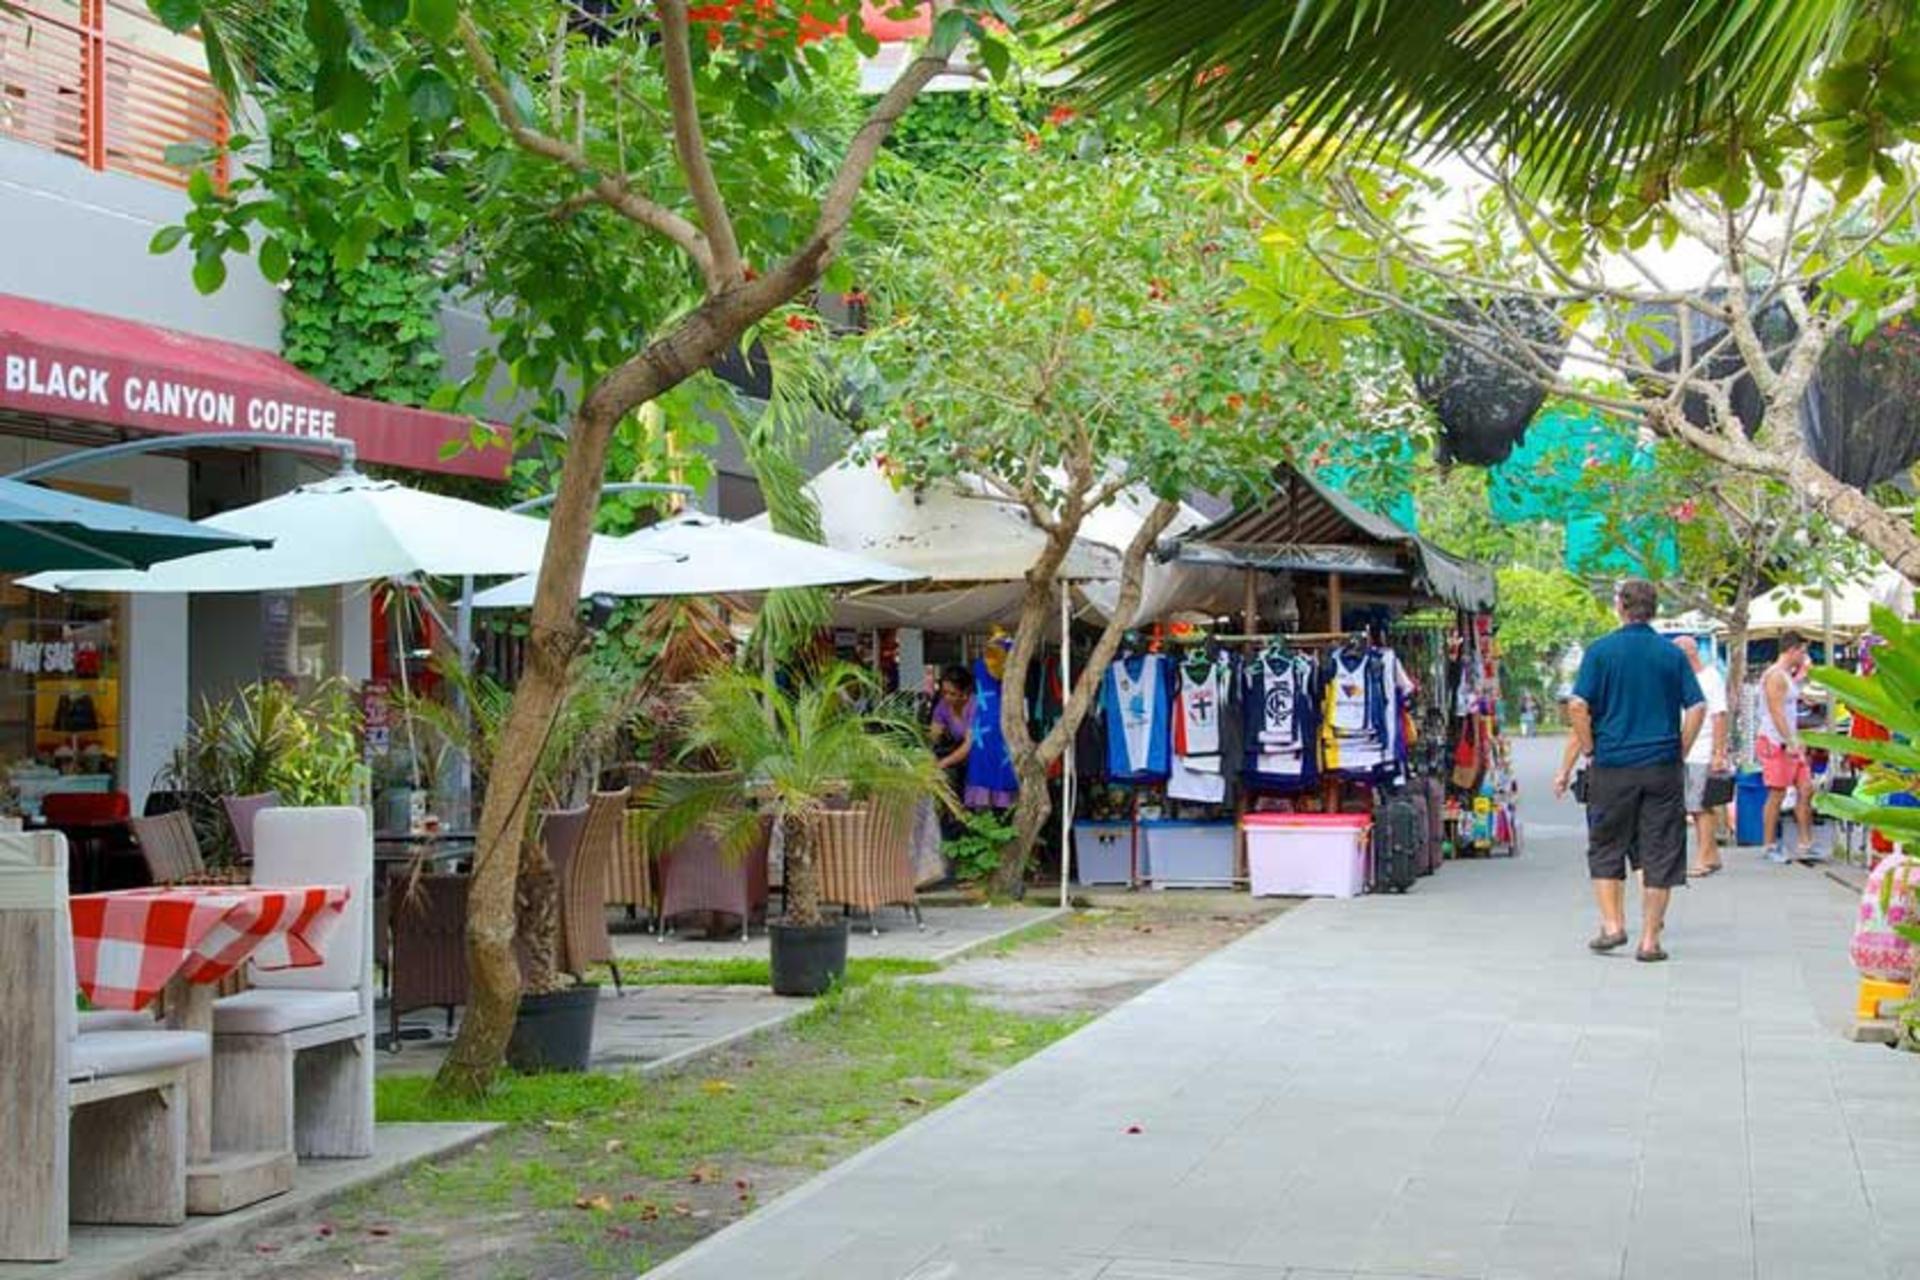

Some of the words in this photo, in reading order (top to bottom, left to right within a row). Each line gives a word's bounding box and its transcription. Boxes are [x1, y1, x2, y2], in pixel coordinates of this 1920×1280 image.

[6, 355, 109, 405] BLACK
[124, 377, 235, 426] CANYON
[248, 398, 336, 440] COFFEE
